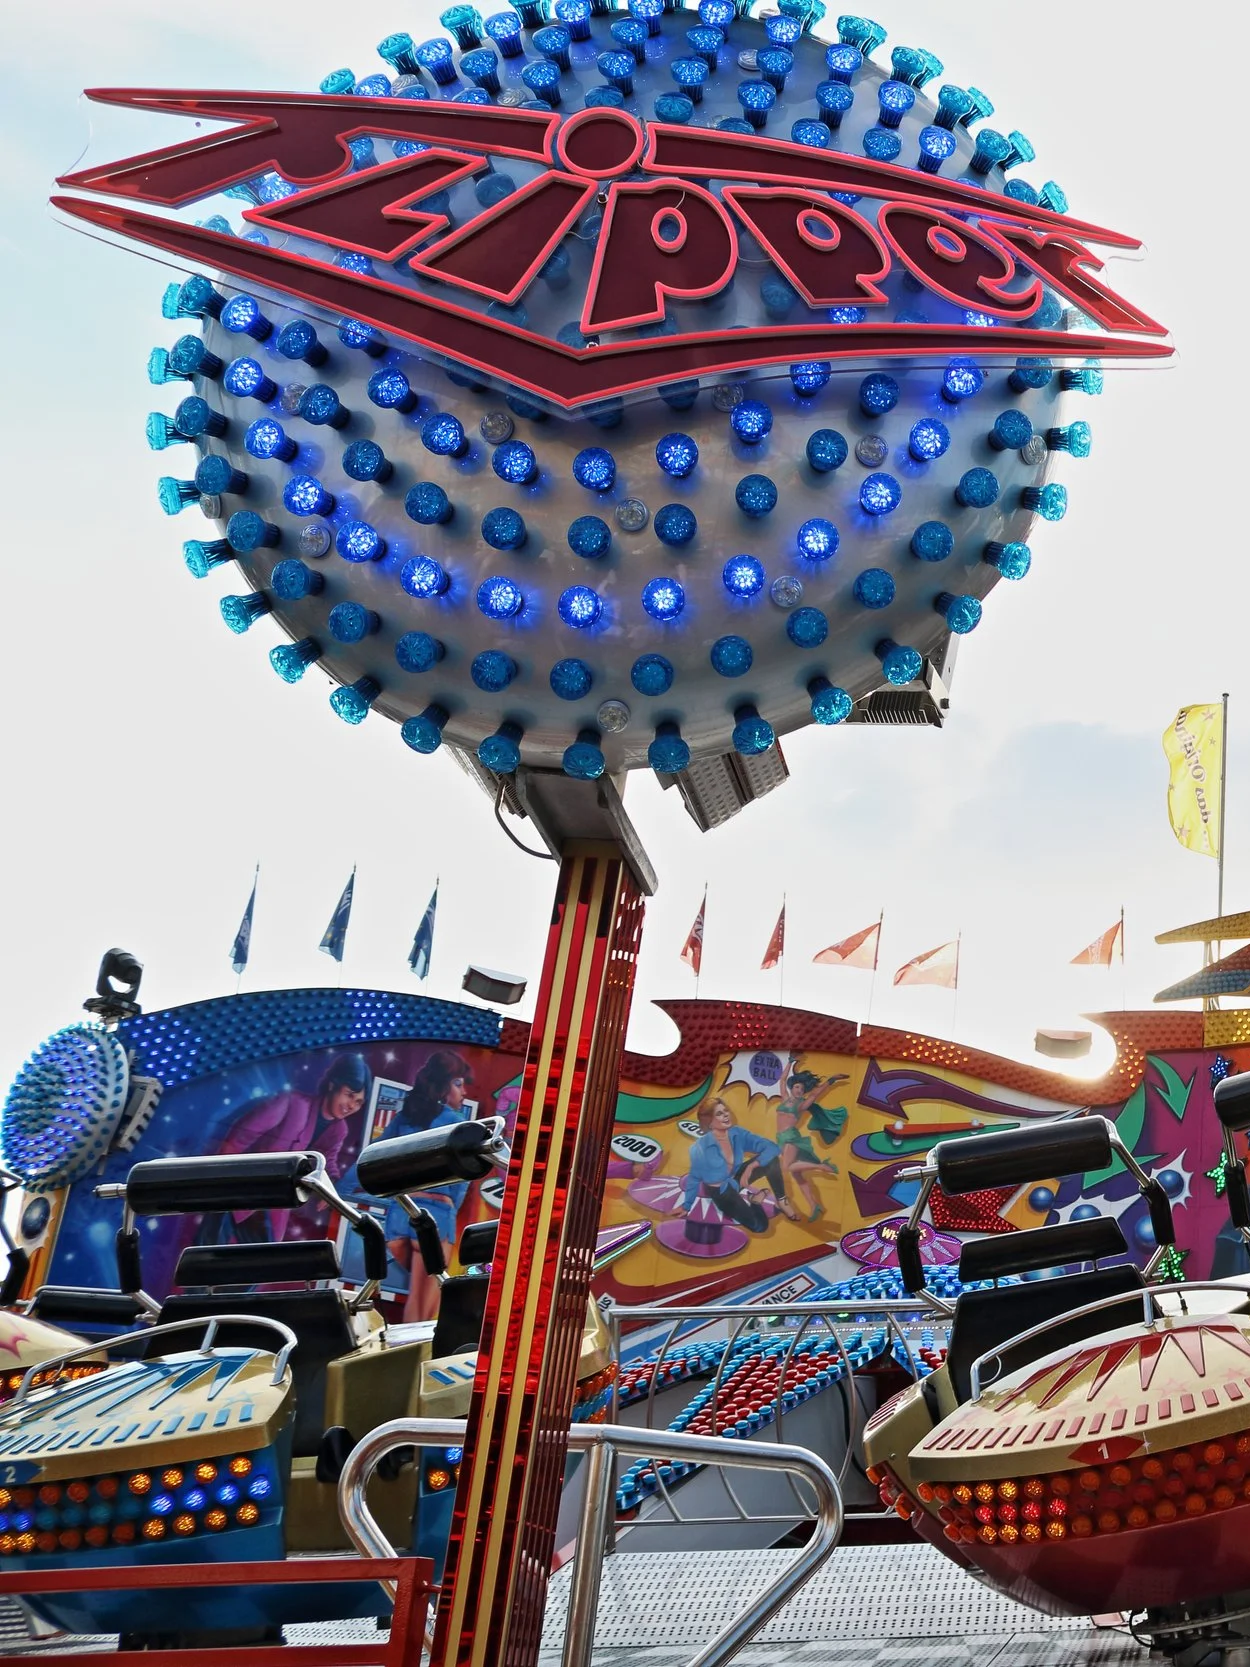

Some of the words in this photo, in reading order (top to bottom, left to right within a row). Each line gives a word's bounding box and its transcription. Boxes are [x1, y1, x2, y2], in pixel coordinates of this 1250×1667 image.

[754, 1055, 781, 1070] EXTRA
[753, 1067, 777, 1081] BALL
[613, 1135, 658, 1158] 2000
[1097, 1442, 1109, 1460] 1
[5, 1465, 17, 1483] 2
